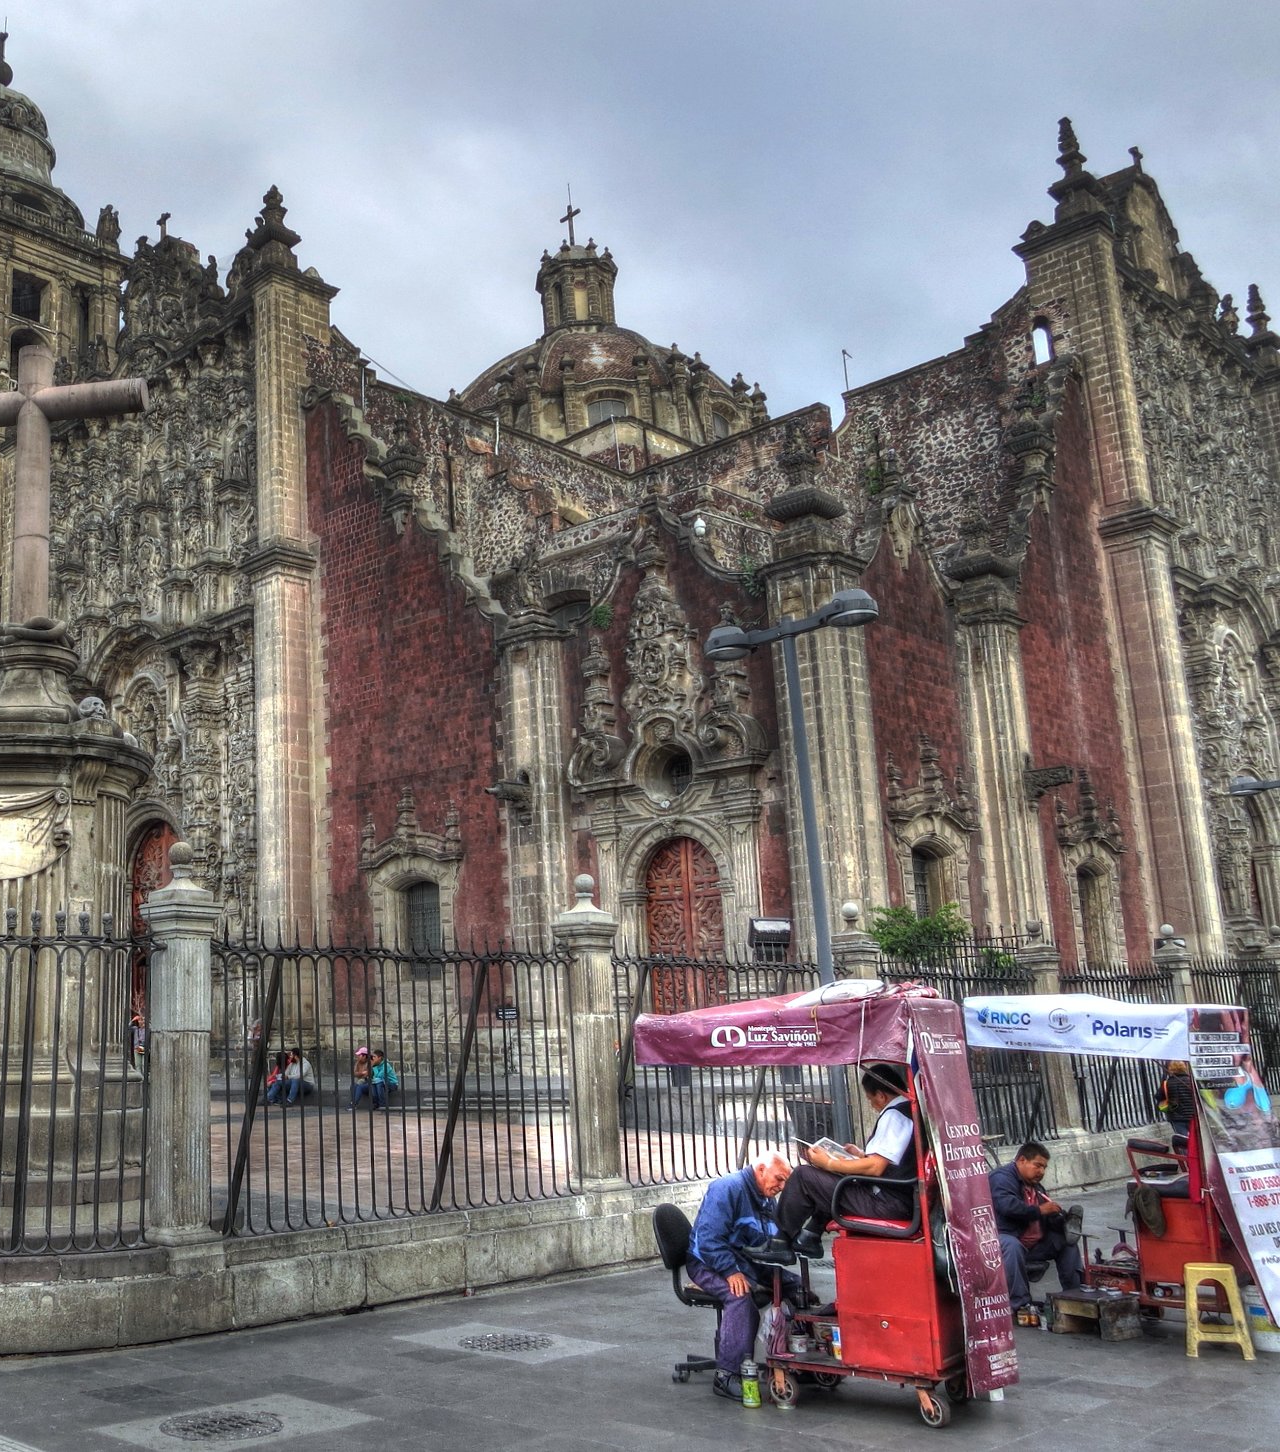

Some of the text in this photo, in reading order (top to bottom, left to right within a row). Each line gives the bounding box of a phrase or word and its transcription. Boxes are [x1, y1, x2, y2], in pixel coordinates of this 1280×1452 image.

[991, 1012, 1031, 1025] RNCC
[748, 1030, 817, 1042] Luz Saviñón
[1092, 1019, 1153, 1039] Polaris
[945, 1121, 980, 1139] CENTRO
